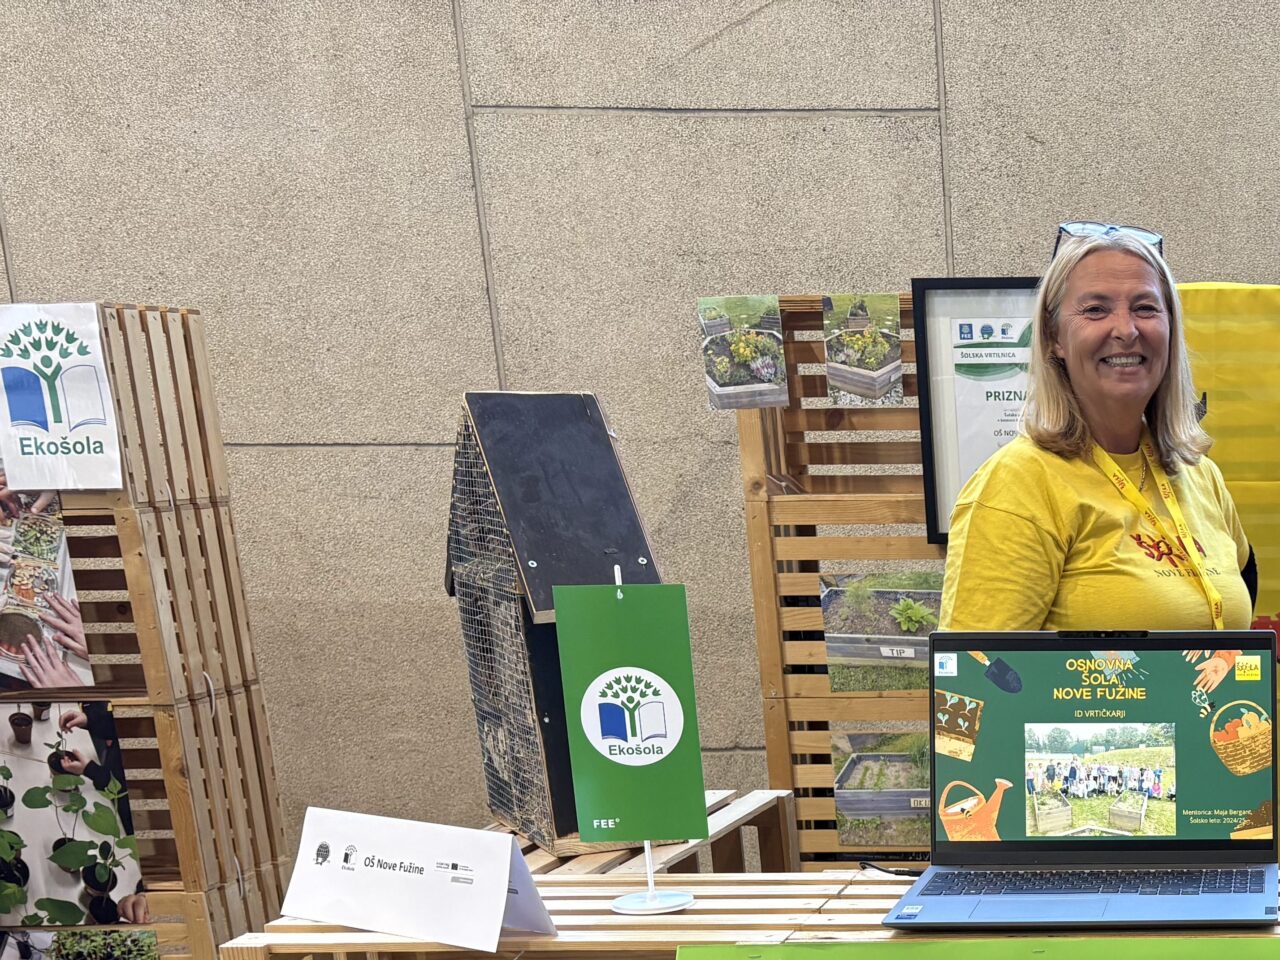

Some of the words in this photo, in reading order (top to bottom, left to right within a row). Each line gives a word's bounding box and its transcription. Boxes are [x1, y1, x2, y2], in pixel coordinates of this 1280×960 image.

[960, 351, 984, 359] ŠOLSKA
[19, 436, 105, 456] Ekošola
[889, 648, 905, 656] TIP
[1066, 658, 1133, 671] OSNOVNA
[1081, 668, 1119, 685] ŠOLA
[1053, 688, 1092, 700] NOVE
[1097, 684, 1146, 700] FUŽINE
[1084, 708, 1126, 719] VRTIČKARJI
[608, 744, 664, 756] Ekošola
[364, 856, 375, 868] OŠ
[376, 859, 398, 871] Nove
[398, 862, 425, 875] Fužine
